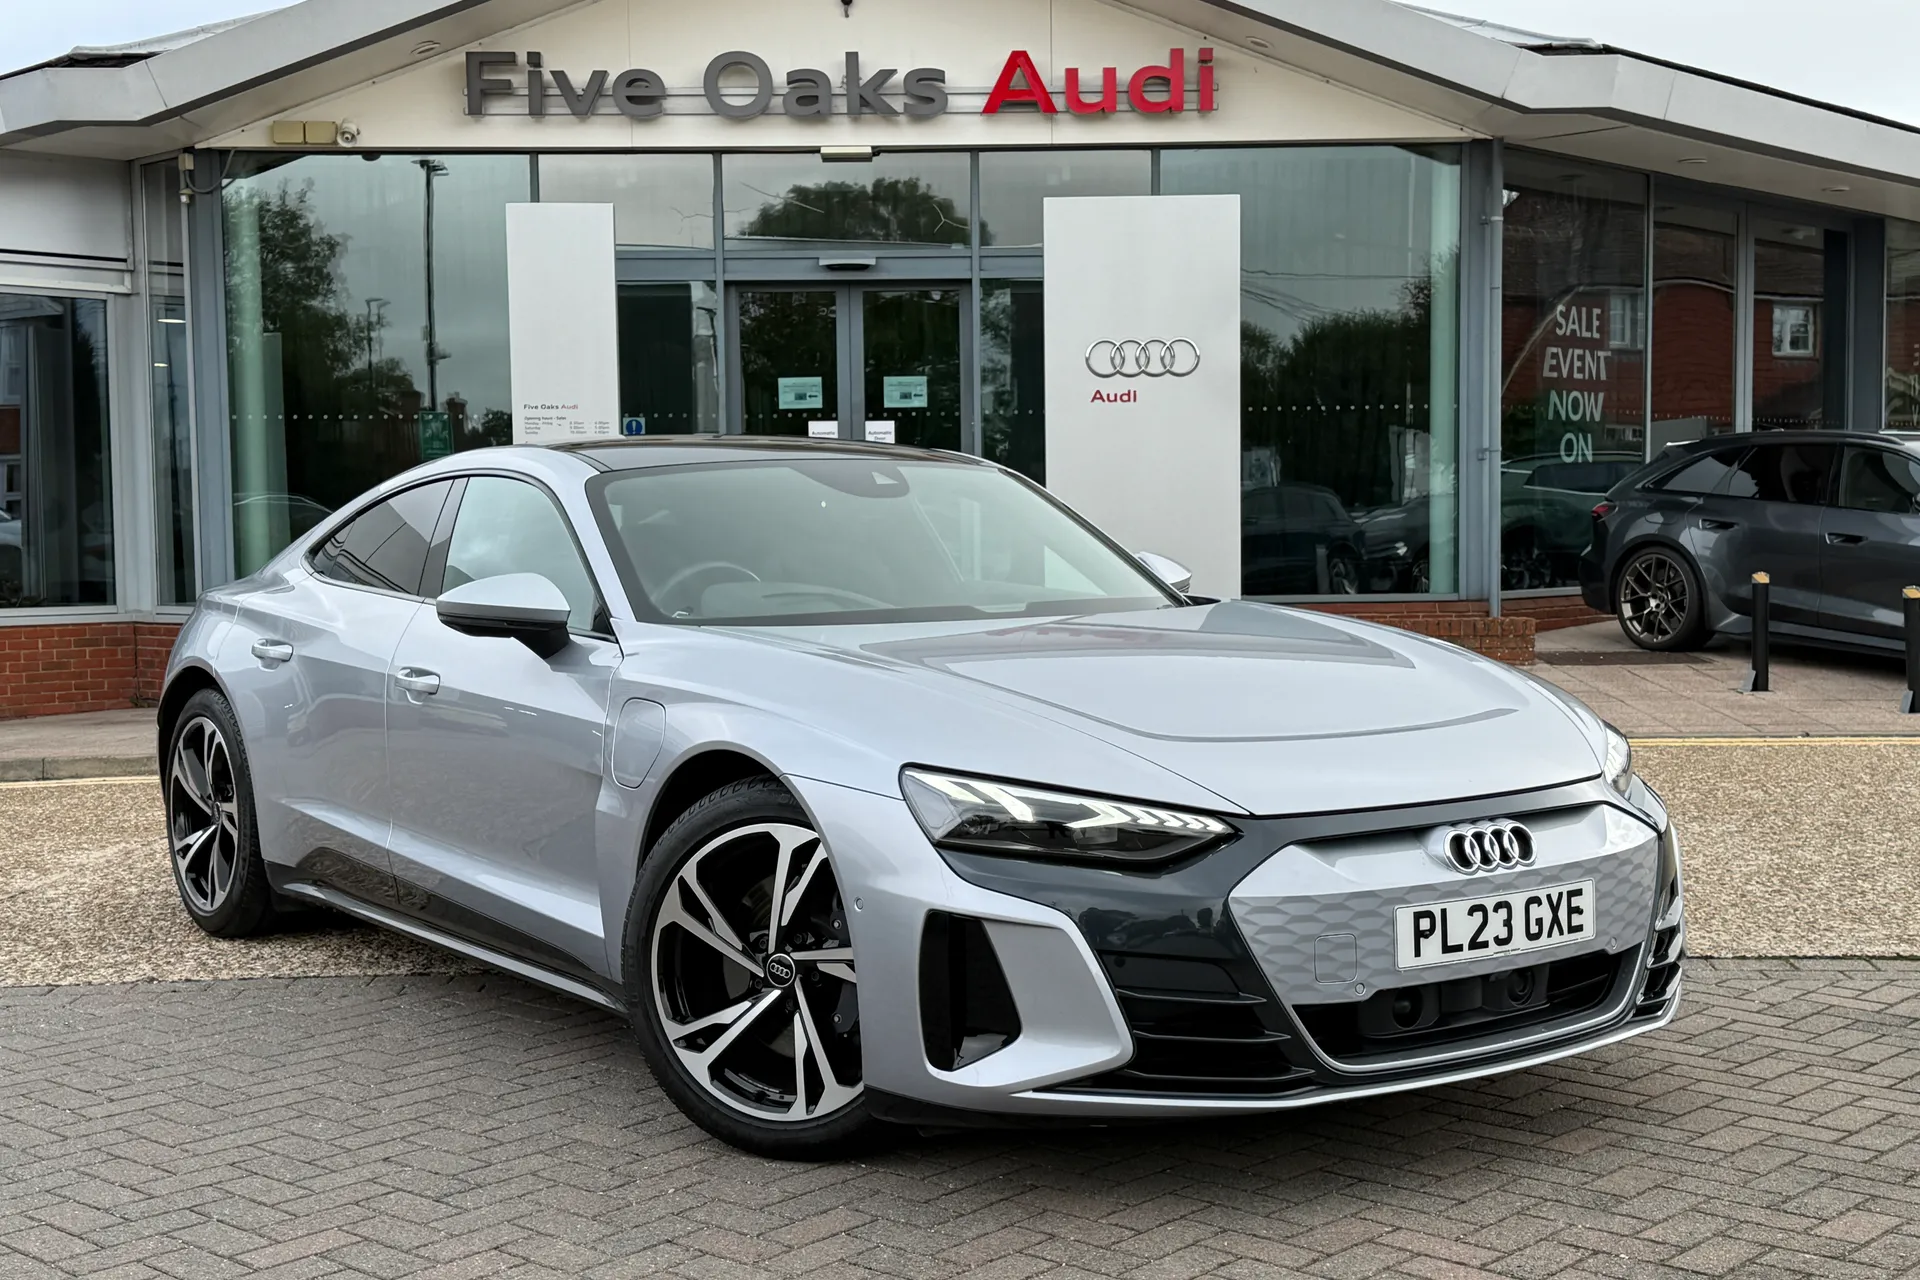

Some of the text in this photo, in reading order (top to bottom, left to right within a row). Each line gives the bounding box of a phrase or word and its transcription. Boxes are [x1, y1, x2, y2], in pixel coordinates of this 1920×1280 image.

[465, 47, 1216, 118] Five Oaks Audi
[1555, 304, 1602, 339] SALE
[1543, 346, 1612, 381] EVENT
[1090, 389, 1137, 402] Audi
[1547, 389, 1605, 422] NOW
[1560, 432, 1594, 463] ON
[1412, 887, 1584, 958] PL23 GXE
